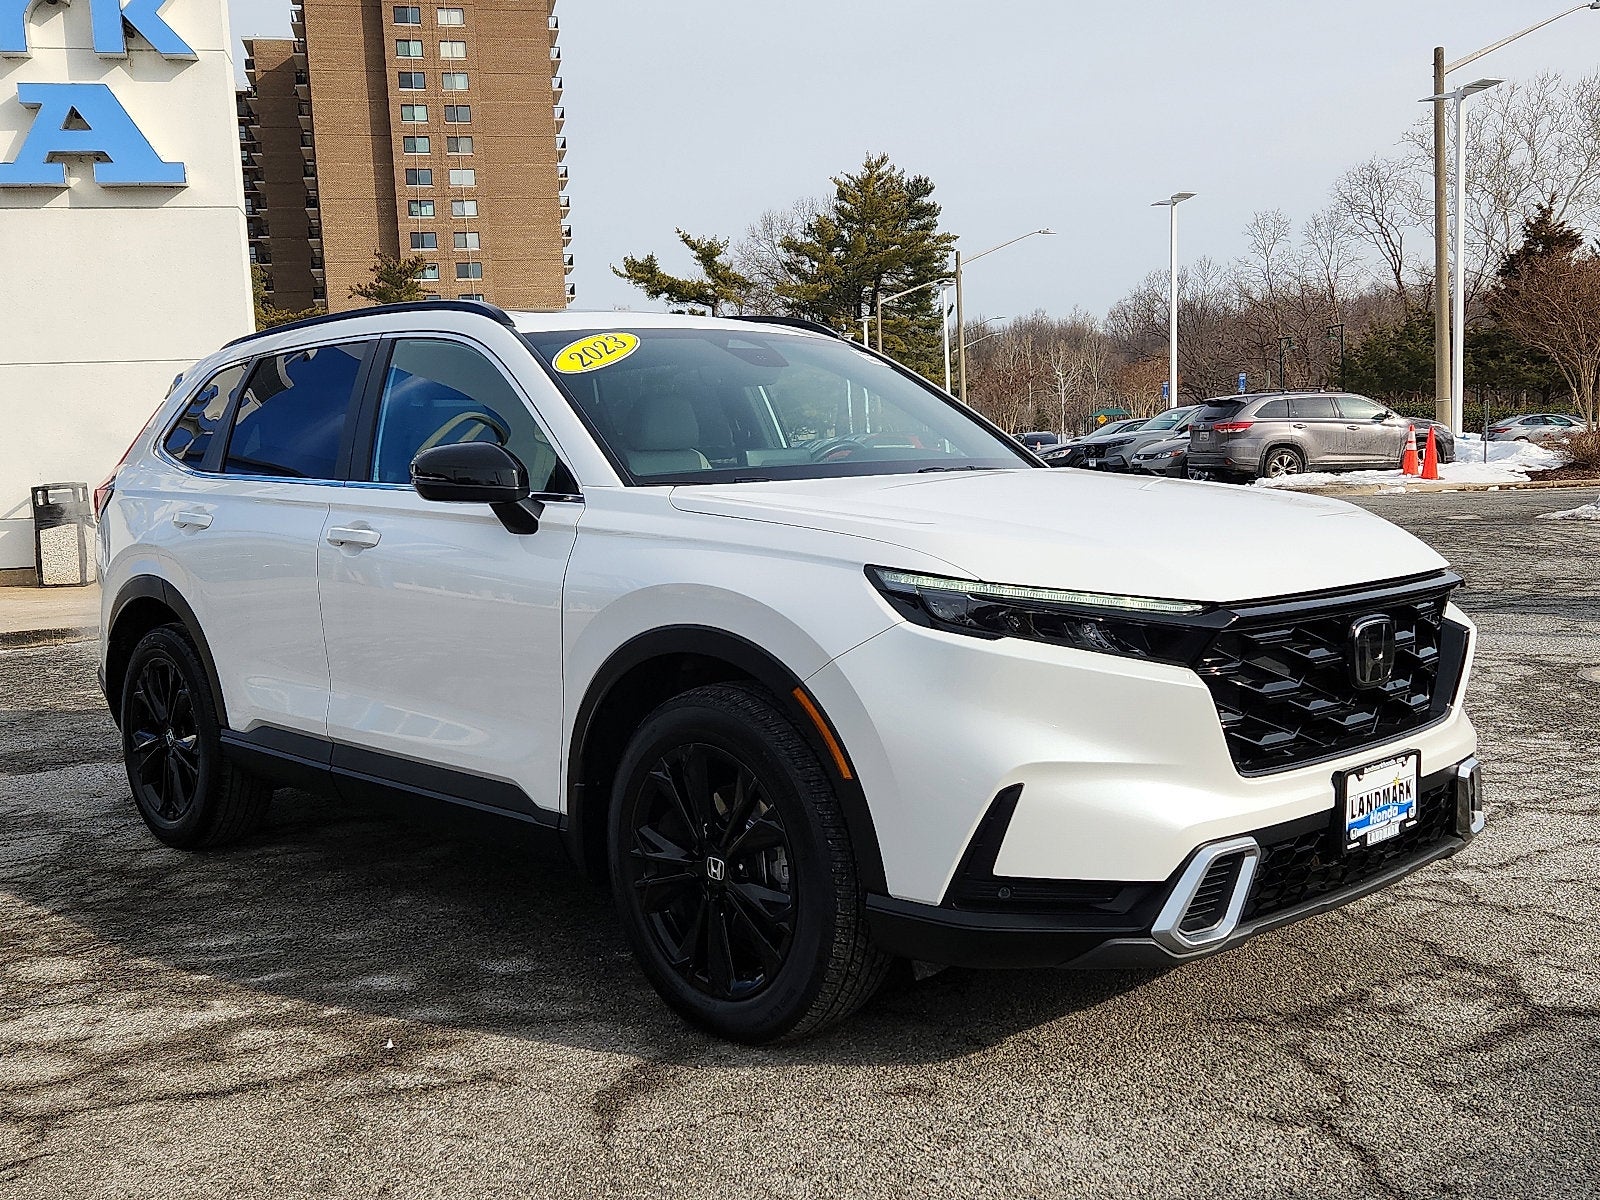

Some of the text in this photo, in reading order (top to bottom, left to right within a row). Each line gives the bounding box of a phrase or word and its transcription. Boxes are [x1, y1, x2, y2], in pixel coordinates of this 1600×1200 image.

[569, 336, 627, 368] 2023
[1350, 779, 1413, 820] LANDMARK
[1369, 805, 1399, 825] Honda
